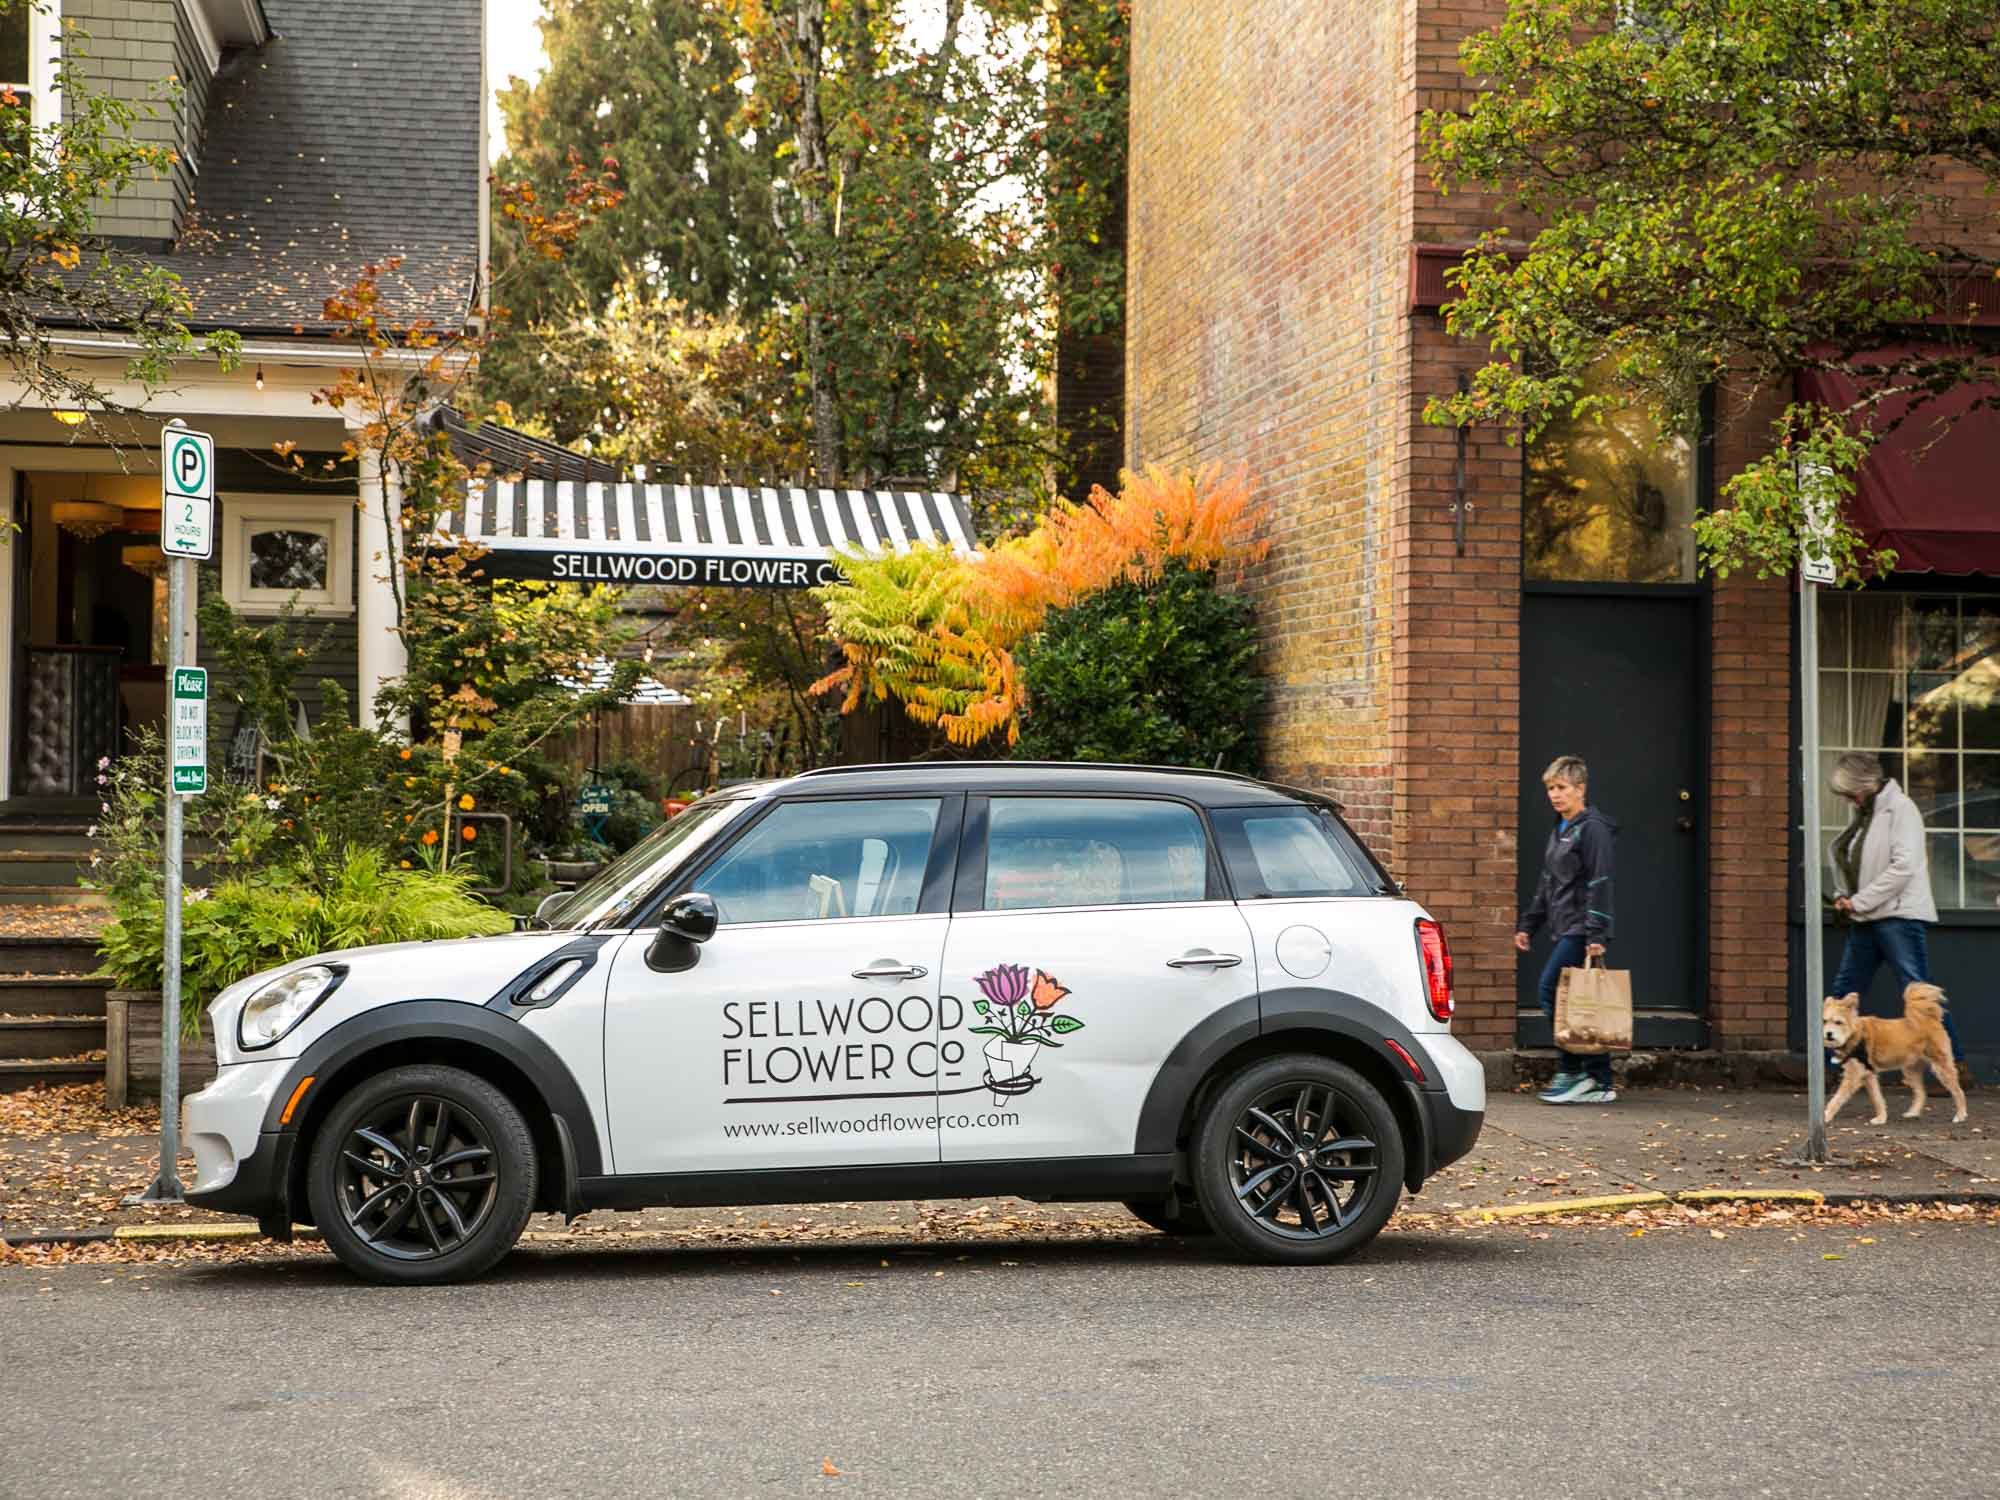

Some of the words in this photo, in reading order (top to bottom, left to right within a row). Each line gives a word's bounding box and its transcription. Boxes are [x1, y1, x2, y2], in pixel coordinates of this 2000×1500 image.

[182, 449, 197, 481] P
[185, 504, 193, 522] 2
[175, 524, 201, 537] HOURS
[552, 553, 697, 581] SELLWOOD
[705, 559, 809, 585] FLOWER
[177, 673, 203, 692] Please
[176, 725, 192, 741] BLOCK
[193, 725, 203, 741] THE
[176, 745, 201, 761] DRIVEWAY
[582, 803, 609, 813] OPEN
[723, 995, 964, 1039] SELLWOOD
[723, 1042, 894, 1085] FLOWER
[724, 1112, 1020, 1138] www.sellwoodflowerco.com
